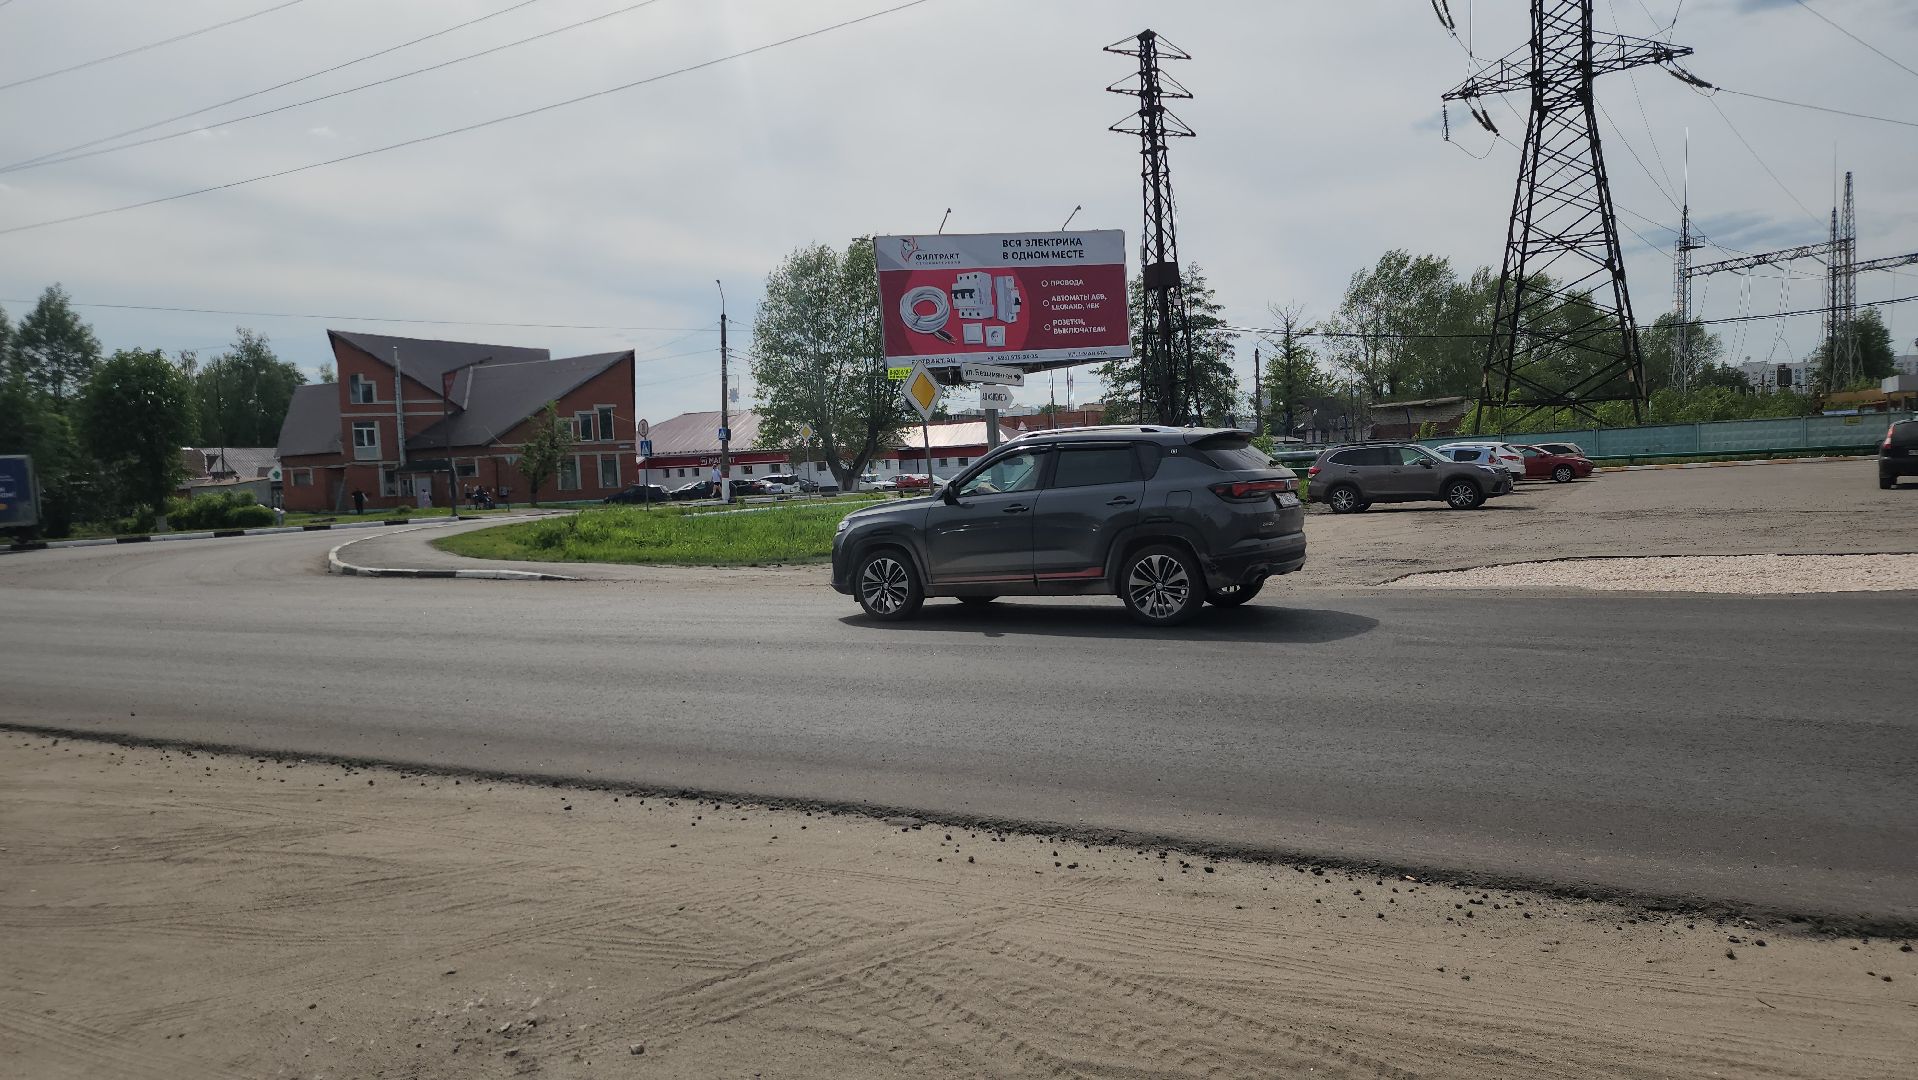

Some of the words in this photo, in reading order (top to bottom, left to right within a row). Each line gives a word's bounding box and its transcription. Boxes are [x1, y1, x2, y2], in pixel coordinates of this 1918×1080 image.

[1002, 239, 1021, 248] ВСЯ
[1025, 238, 1083, 248] ЭЛЕКТРИКА
[1002, 251, 1009, 260] В
[1012, 250, 1050, 261] ОДНОМ
[1052, 249, 1085, 259] МЕСТЕ
[1050, 279, 1084, 287] ПРОВОДА
[1051, 293, 1090, 302] АВТОМАТЫ
[1052, 318, 1086, 326] РОЗЕТКИ,
[1053, 326, 1106, 335] ВЫКЛЮЧАТЕЛИ
[964, 369, 975, 377] ул.
